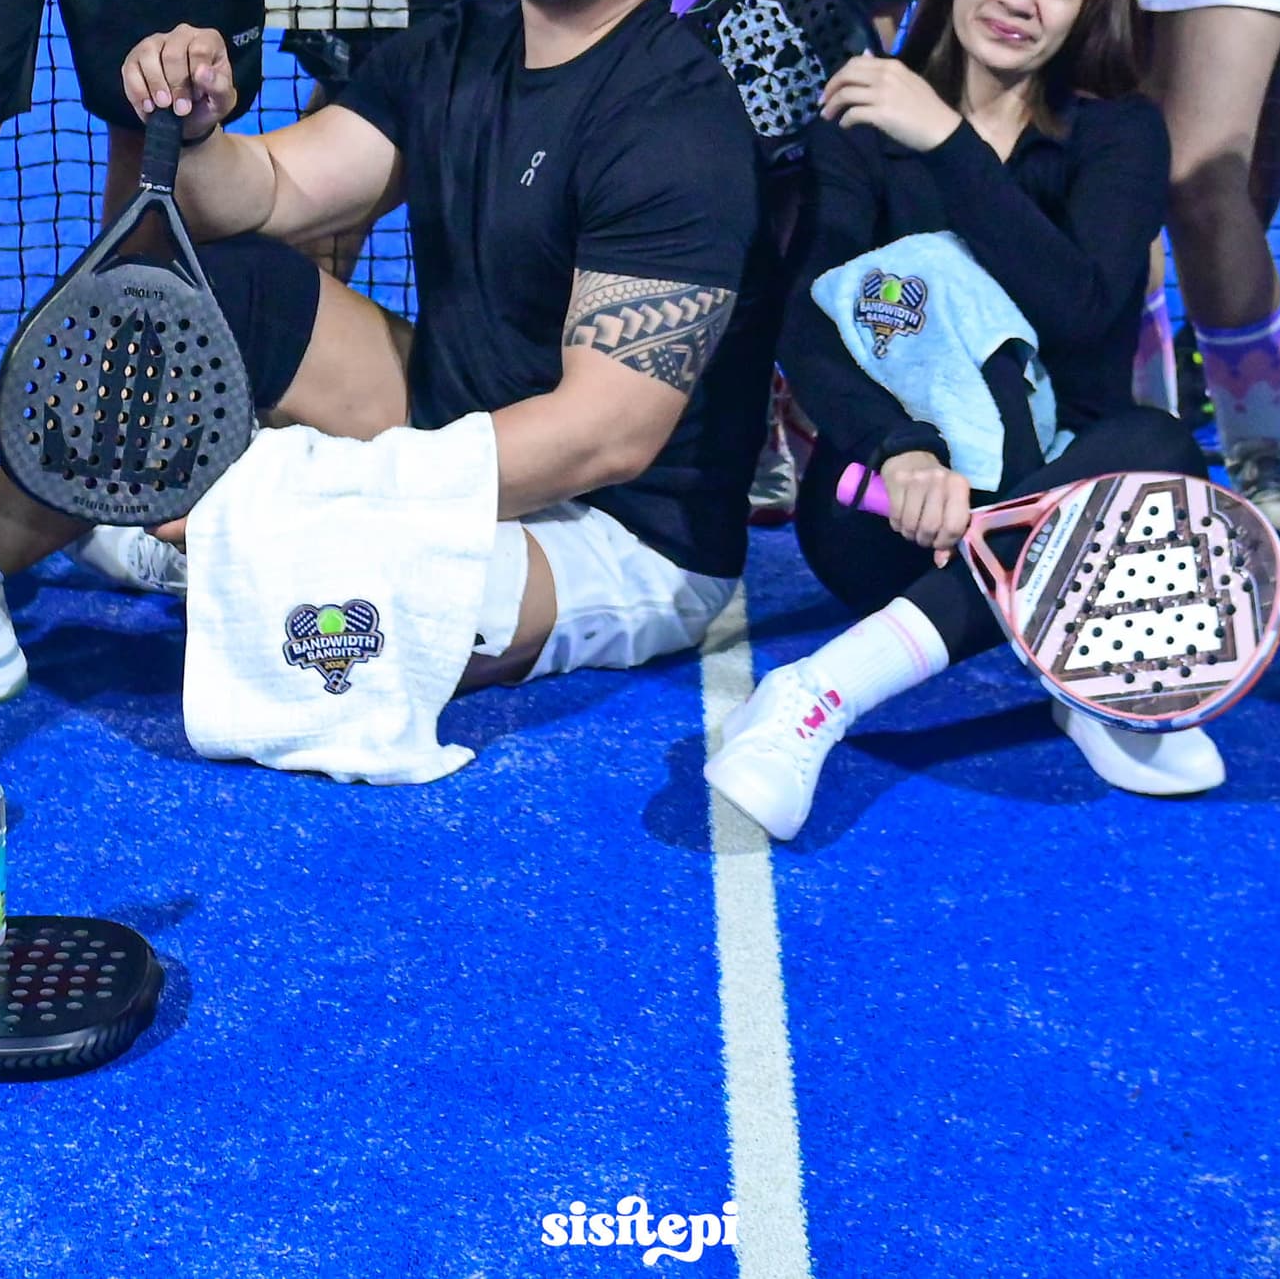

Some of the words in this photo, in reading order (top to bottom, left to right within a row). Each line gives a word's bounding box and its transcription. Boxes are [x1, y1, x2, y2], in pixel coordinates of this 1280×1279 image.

[860, 301, 919, 326] BANDWIDTH
[291, 634, 377, 655] BANDWIDTH
[305, 646, 363, 661] BANDITS
